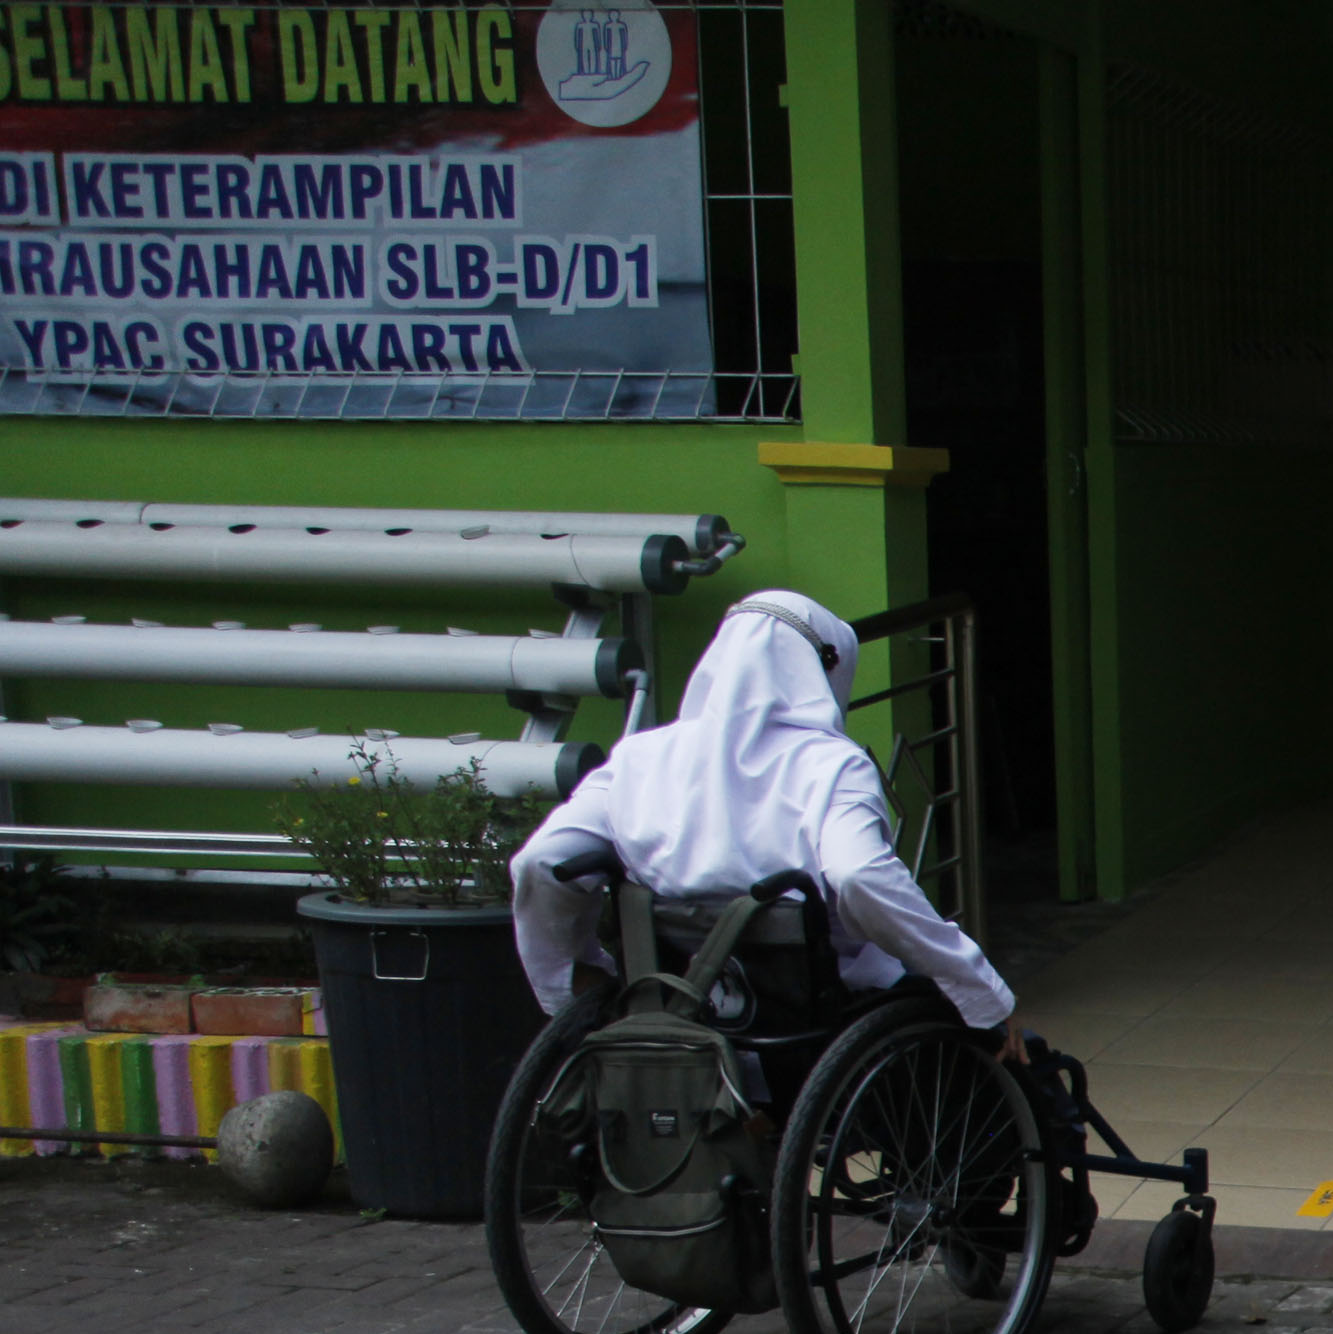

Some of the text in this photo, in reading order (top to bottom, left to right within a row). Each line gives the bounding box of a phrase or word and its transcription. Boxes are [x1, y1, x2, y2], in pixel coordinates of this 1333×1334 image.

[0, 7, 518, 103] ELAMAT DATANG
[72, 162, 516, 219] KETERAMPILAN
[387, 243, 649, 306] SLB-D/D1
[14, 320, 524, 378] YPAC SURAKARTA
